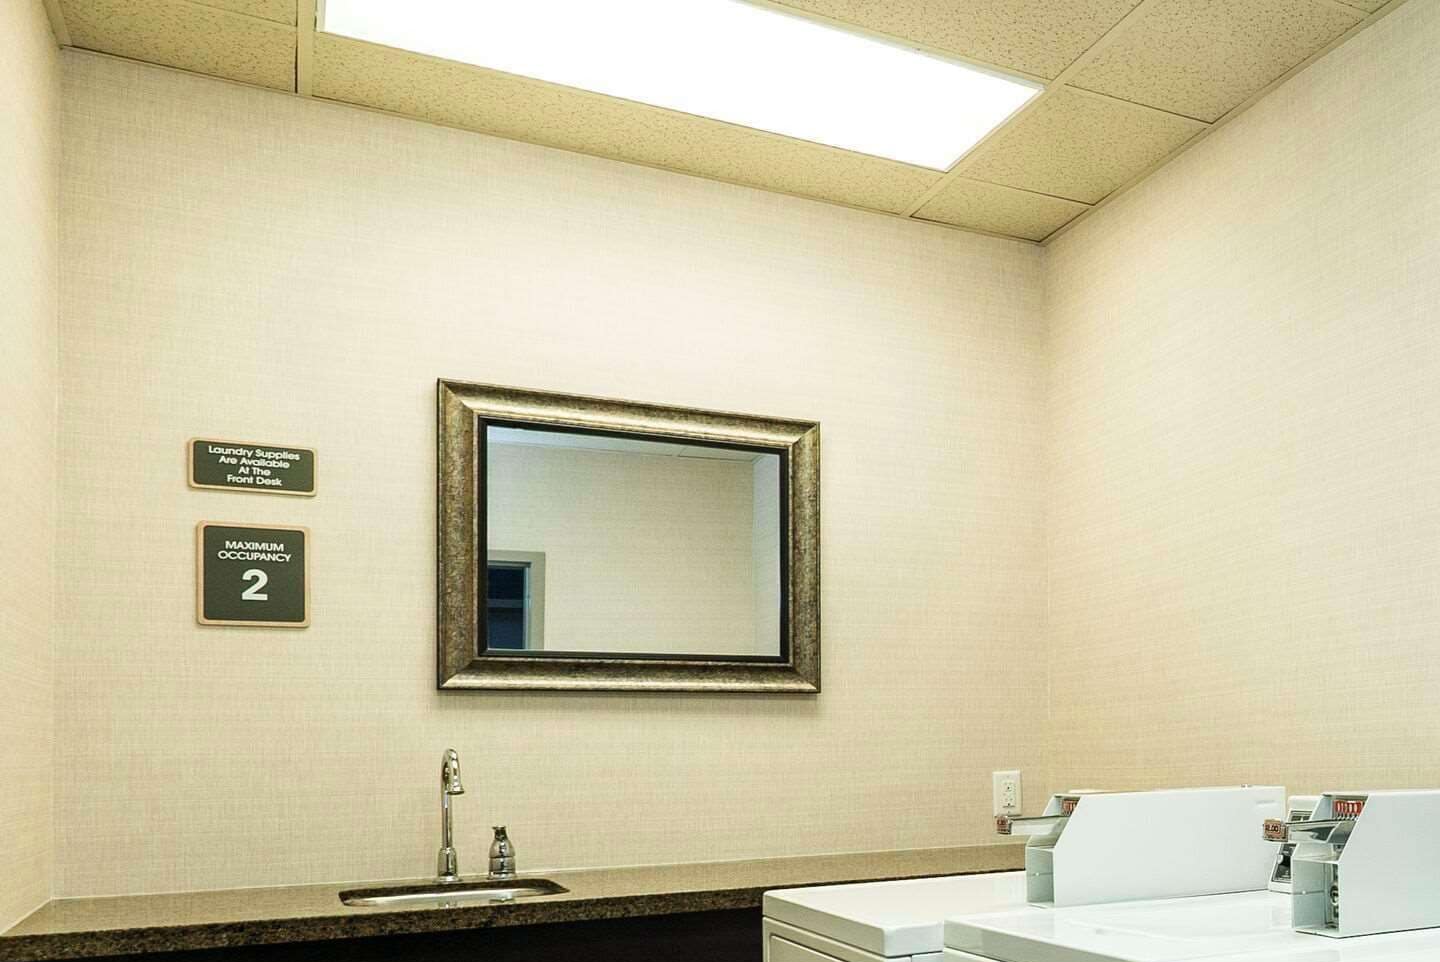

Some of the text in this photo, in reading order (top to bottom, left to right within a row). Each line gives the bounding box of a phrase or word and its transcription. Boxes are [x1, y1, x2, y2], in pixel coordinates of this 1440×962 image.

[208, 445, 300, 461] Laundry Supplies
[218, 455, 290, 469] Are Available
[238, 466, 271, 476] At The
[226, 474, 283, 487] Front Desk
[225, 540, 285, 552] MAXIMUM
[217, 550, 292, 563] OCCUPANCY
[241, 568, 269, 601] 2
